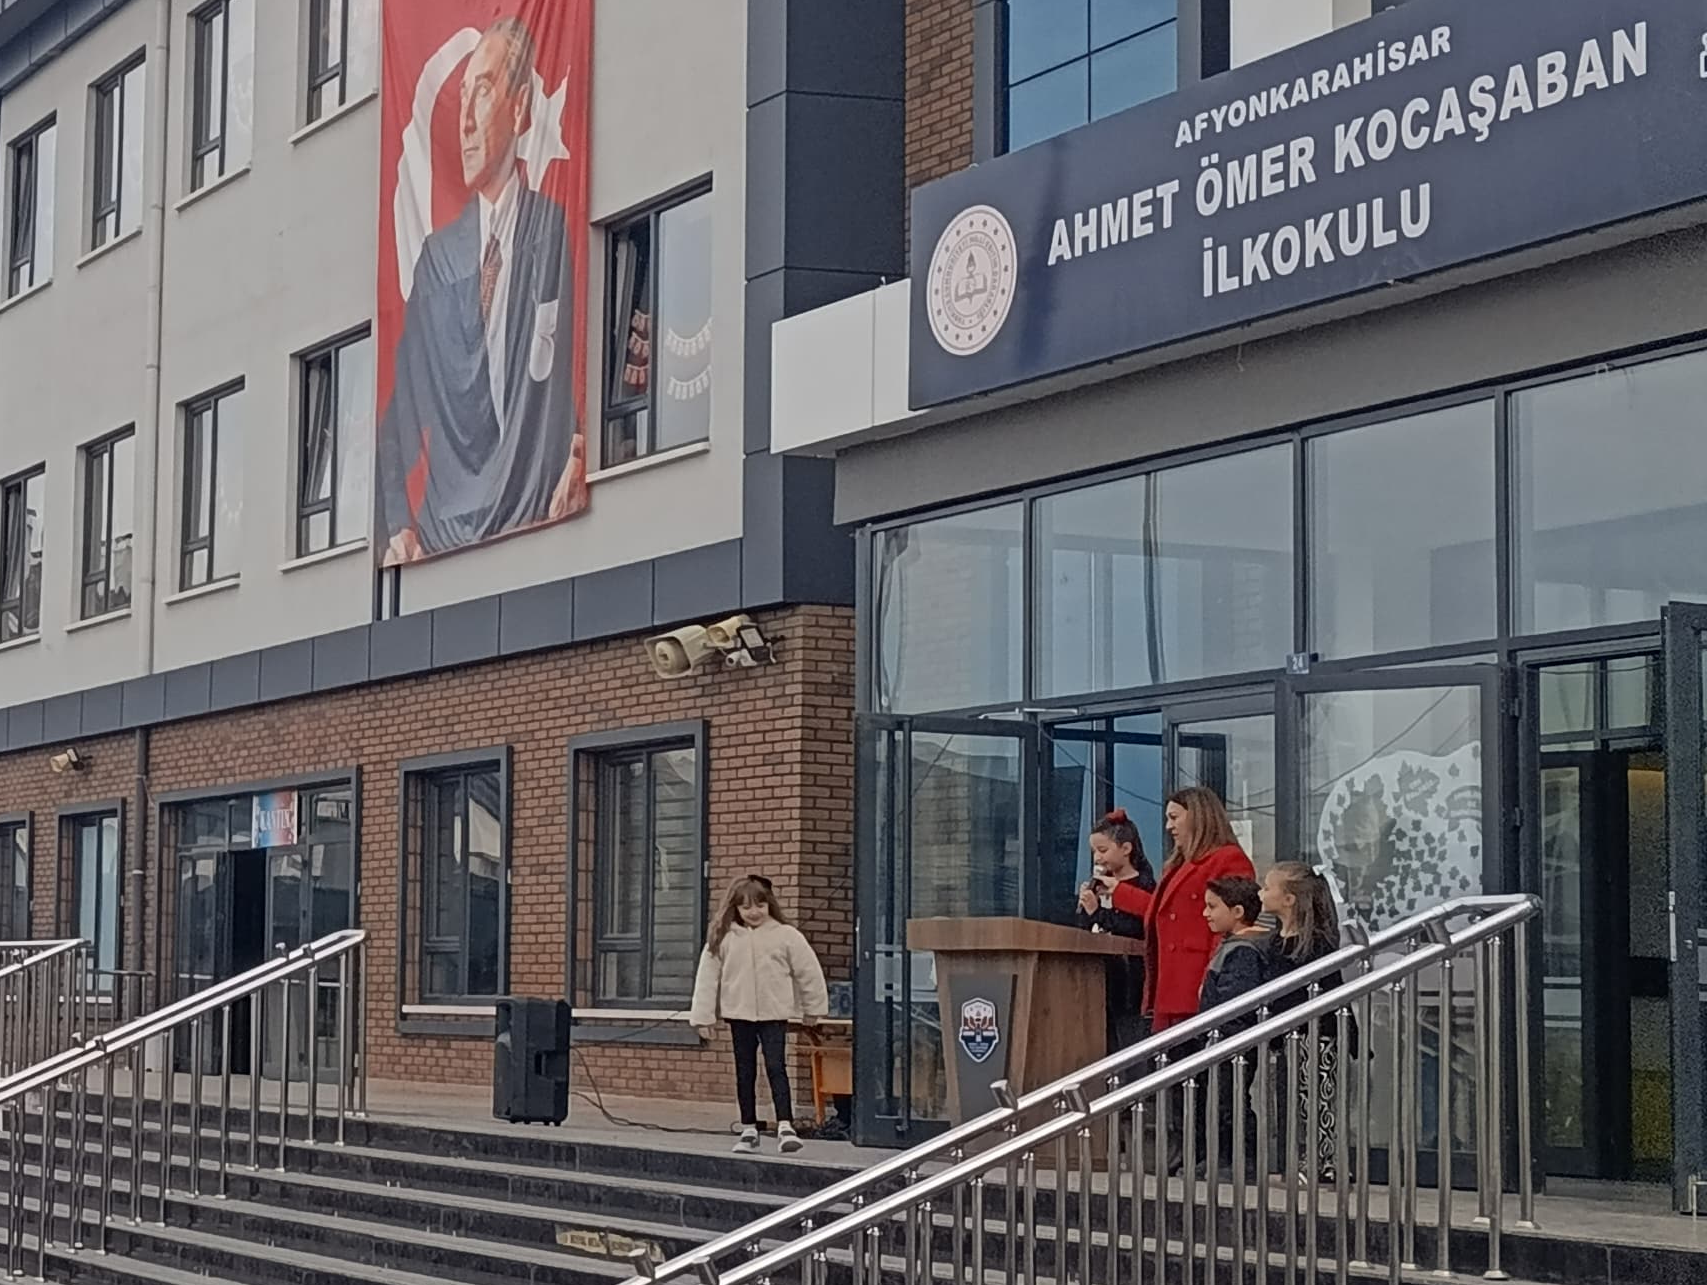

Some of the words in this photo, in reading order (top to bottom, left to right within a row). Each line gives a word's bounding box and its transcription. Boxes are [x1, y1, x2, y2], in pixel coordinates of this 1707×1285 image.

[1047, 179, 1181, 267] AHMET
[1195, 135, 1317, 216] ÖMER
[1333, 21, 1648, 174] KOCAŞABAN
[1175, 25, 1452, 149] AFYONKARAHİSAR
[1202, 182, 1431, 298] İLKOKULU
